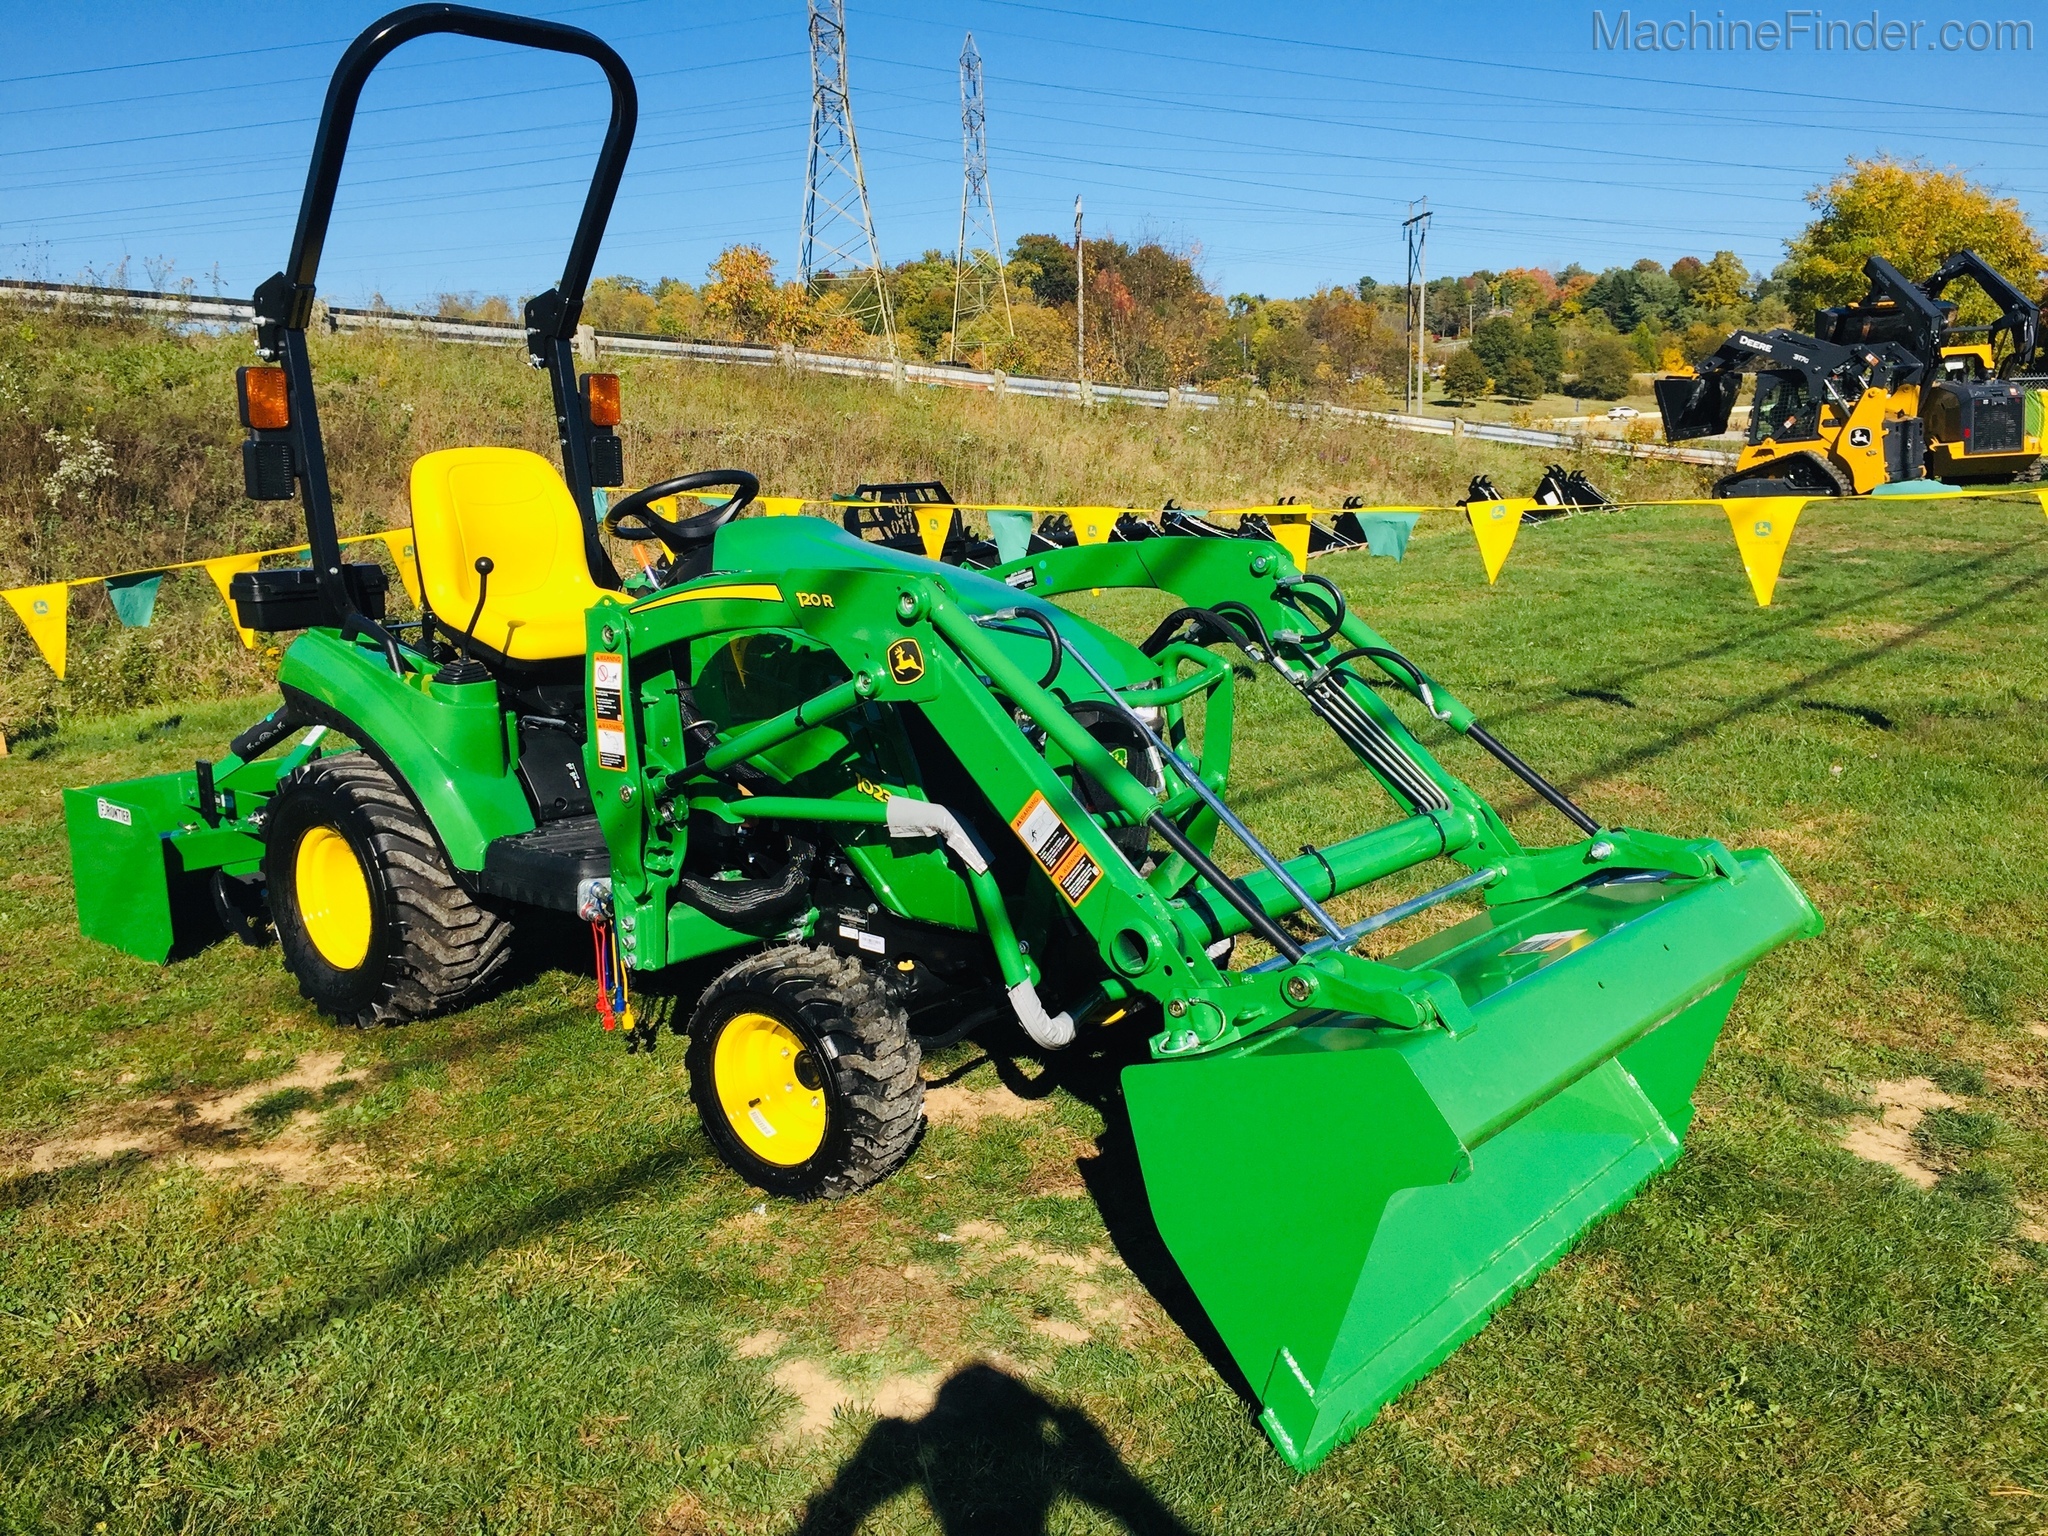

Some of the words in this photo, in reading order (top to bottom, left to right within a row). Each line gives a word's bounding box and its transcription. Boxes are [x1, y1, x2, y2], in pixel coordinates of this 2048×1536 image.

[1739, 335, 1773, 353] DEERE
[1020, 797, 1039, 821] WARNING
[1063, 849, 1082, 873] WARNING
